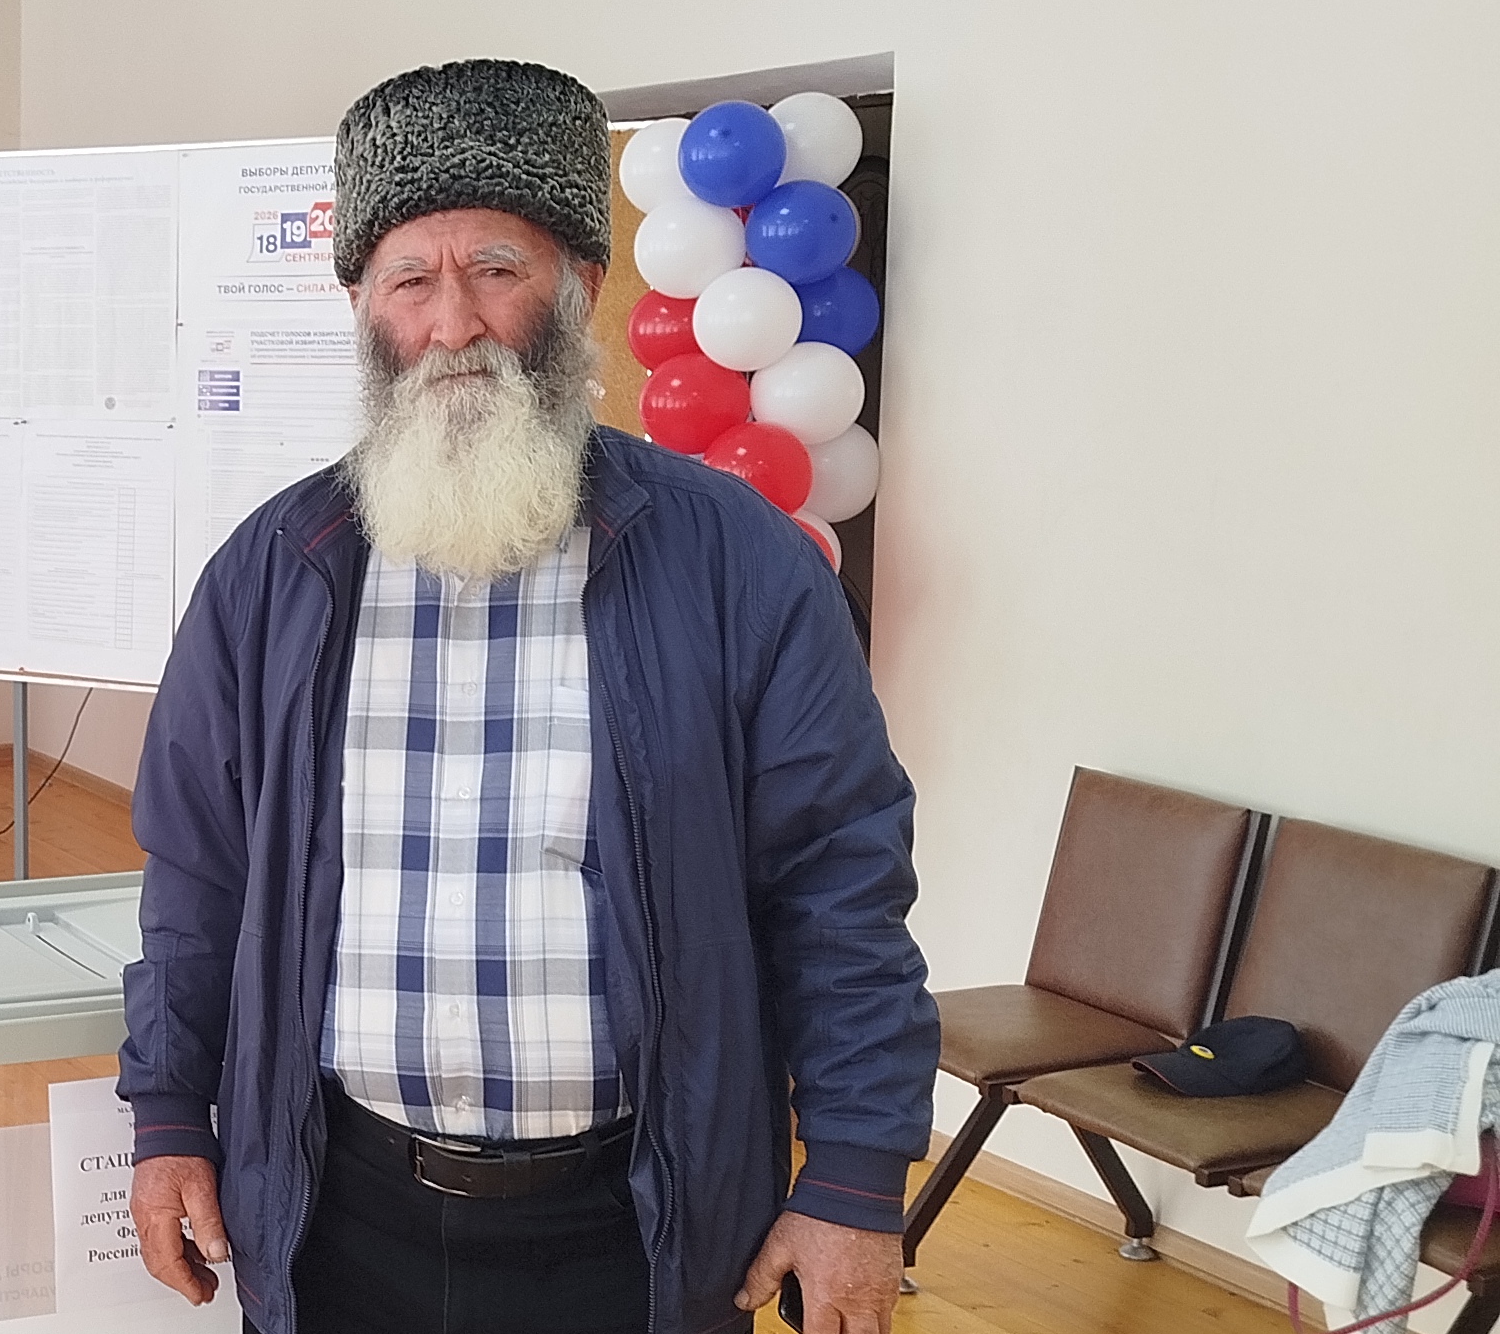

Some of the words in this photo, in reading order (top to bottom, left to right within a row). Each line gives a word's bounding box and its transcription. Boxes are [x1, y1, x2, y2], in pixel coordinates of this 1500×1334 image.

[241, 166, 288, 178] ВЫБОРЫ
[238, 181, 328, 195] ГОСУДАРСТВЕННОЙ
[253, 210, 279, 221] 2026
[283, 220, 307, 243] 19
[256, 234, 278, 254] 18
[216, 282, 246, 294] ТВОЙ
[248, 283, 284, 294] ГОЛОС
[296, 283, 327, 293] СИЛА
[80, 1152, 135, 1173] СТАЦ
[100, 1190, 127, 1203] для
[88, 1243, 141, 1263] Россий
